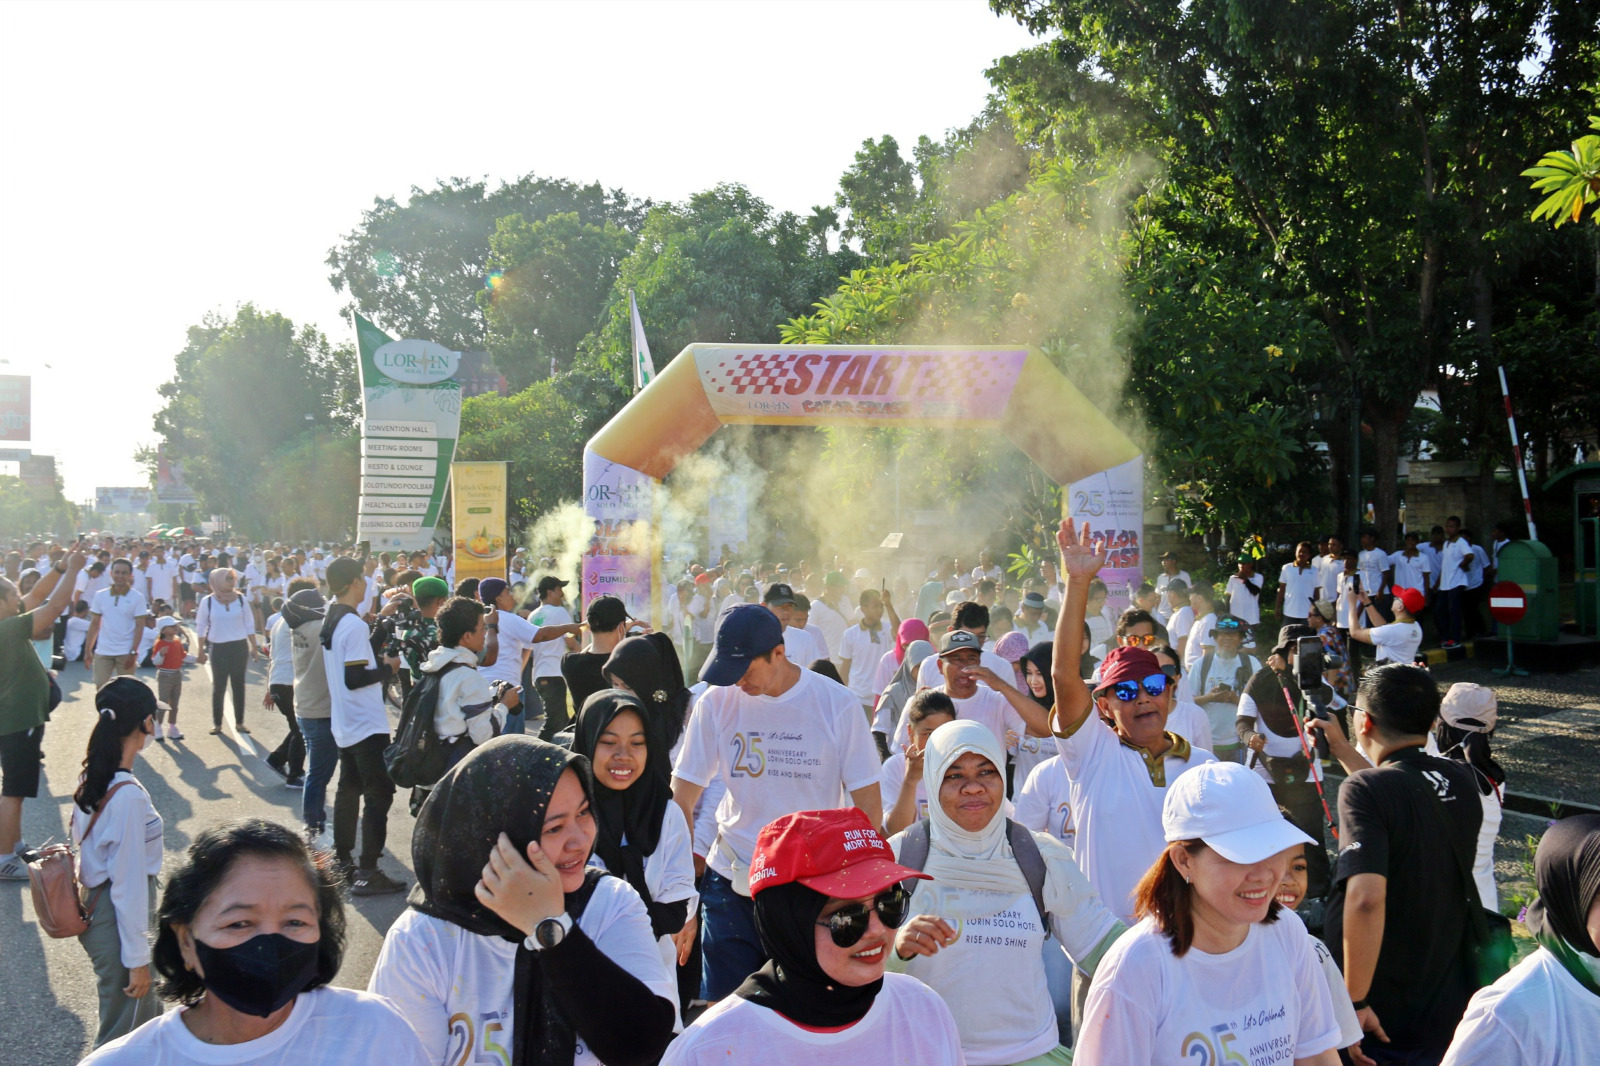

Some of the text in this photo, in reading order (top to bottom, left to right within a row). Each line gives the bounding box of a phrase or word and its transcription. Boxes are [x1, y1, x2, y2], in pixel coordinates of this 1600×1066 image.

[785, 354, 929, 396] START
[367, 424, 411, 432] CONVENTION
[367, 444, 423, 453] MEETING ROOMS
[364, 501, 407, 509] HEALTHCLUB
[360, 520, 393, 528] BUSINESS
[1107, 589, 1129, 597] UMID
[767, 749, 807, 758] ANNIVERSARY
[767, 755, 784, 763] LORIN
[785, 757, 802, 765] SOLO
[767, 769, 812, 780] RISE AND SHINE
[843, 829, 878, 841] RUN FOR
[843, 839, 868, 852] MDRT
[966, 917, 1037, 932] LORIN SOLO HOTEL
[965, 935, 1028, 948] RISE AND SHINE
